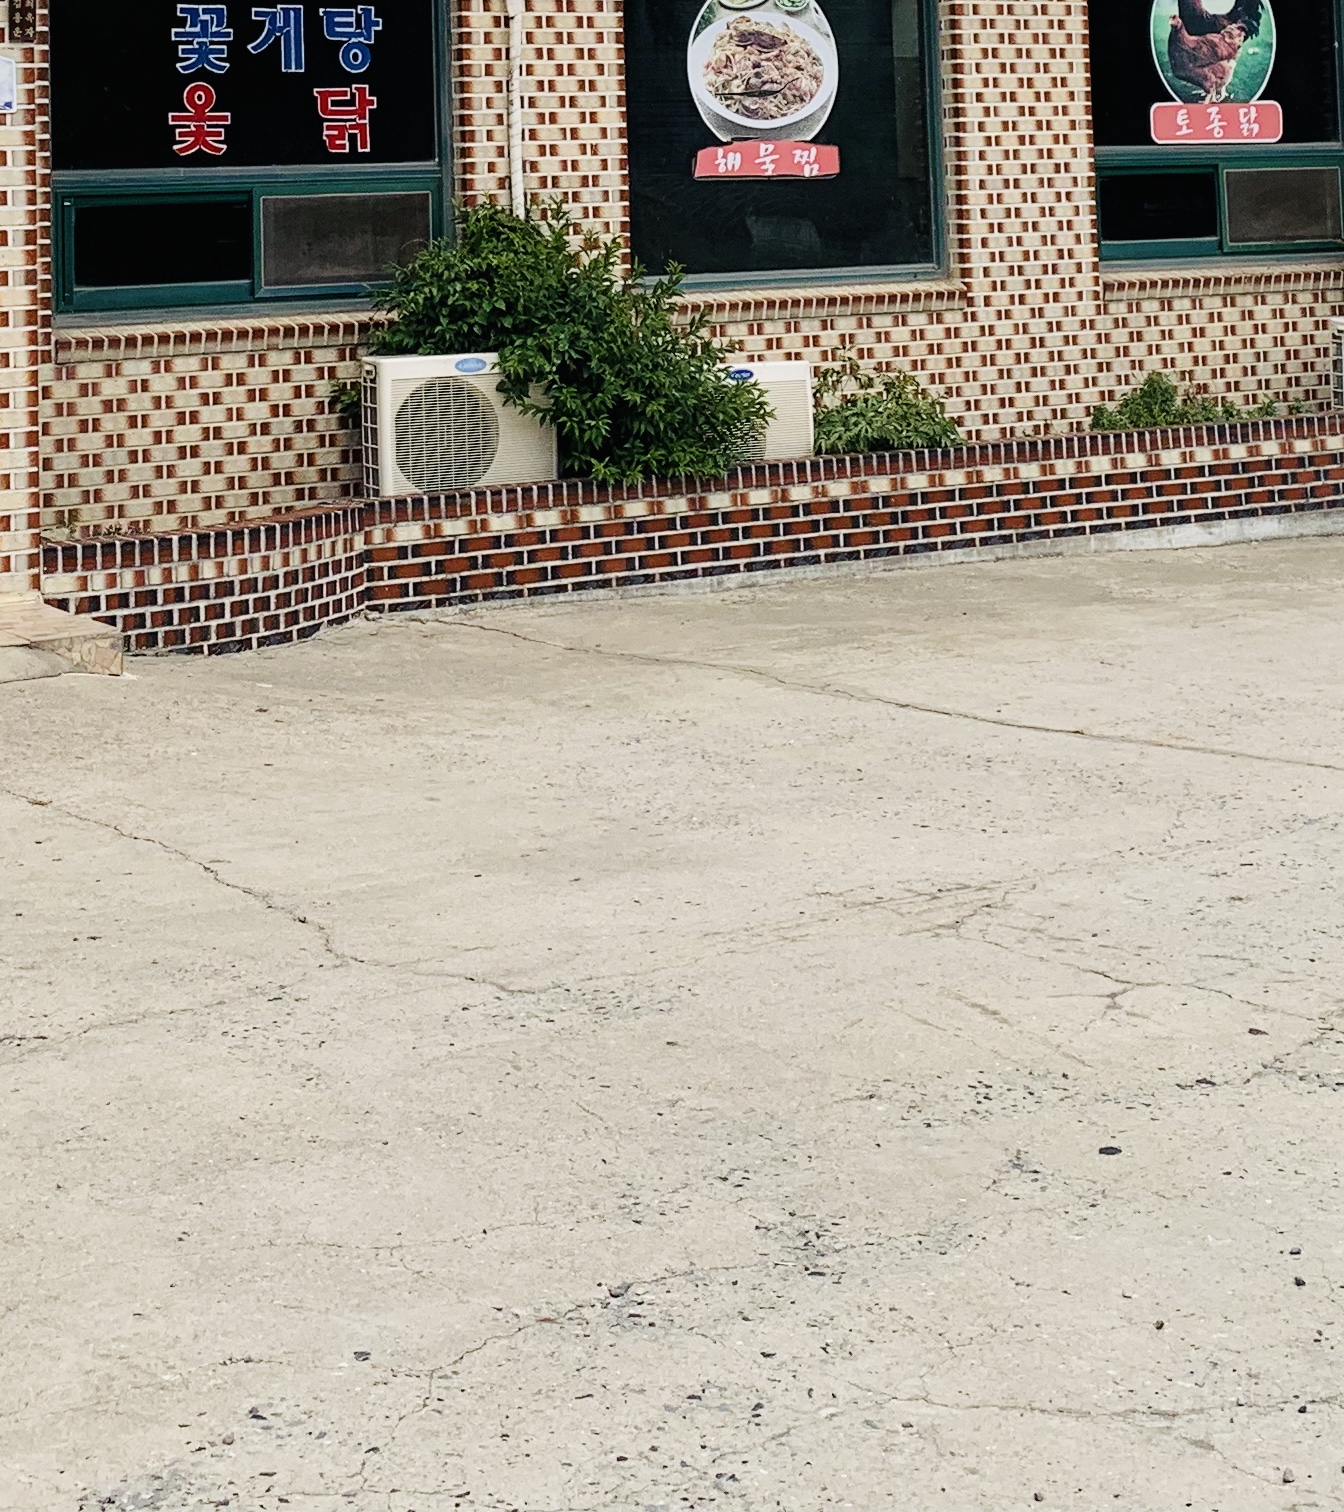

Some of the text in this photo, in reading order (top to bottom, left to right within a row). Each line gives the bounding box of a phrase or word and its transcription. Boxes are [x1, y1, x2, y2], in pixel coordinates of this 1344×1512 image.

[171, 4, 383, 74] 꽃게탕
[1175, 106, 1260, 139] 토종닭
[713, 143, 820, 177] 해물찜
